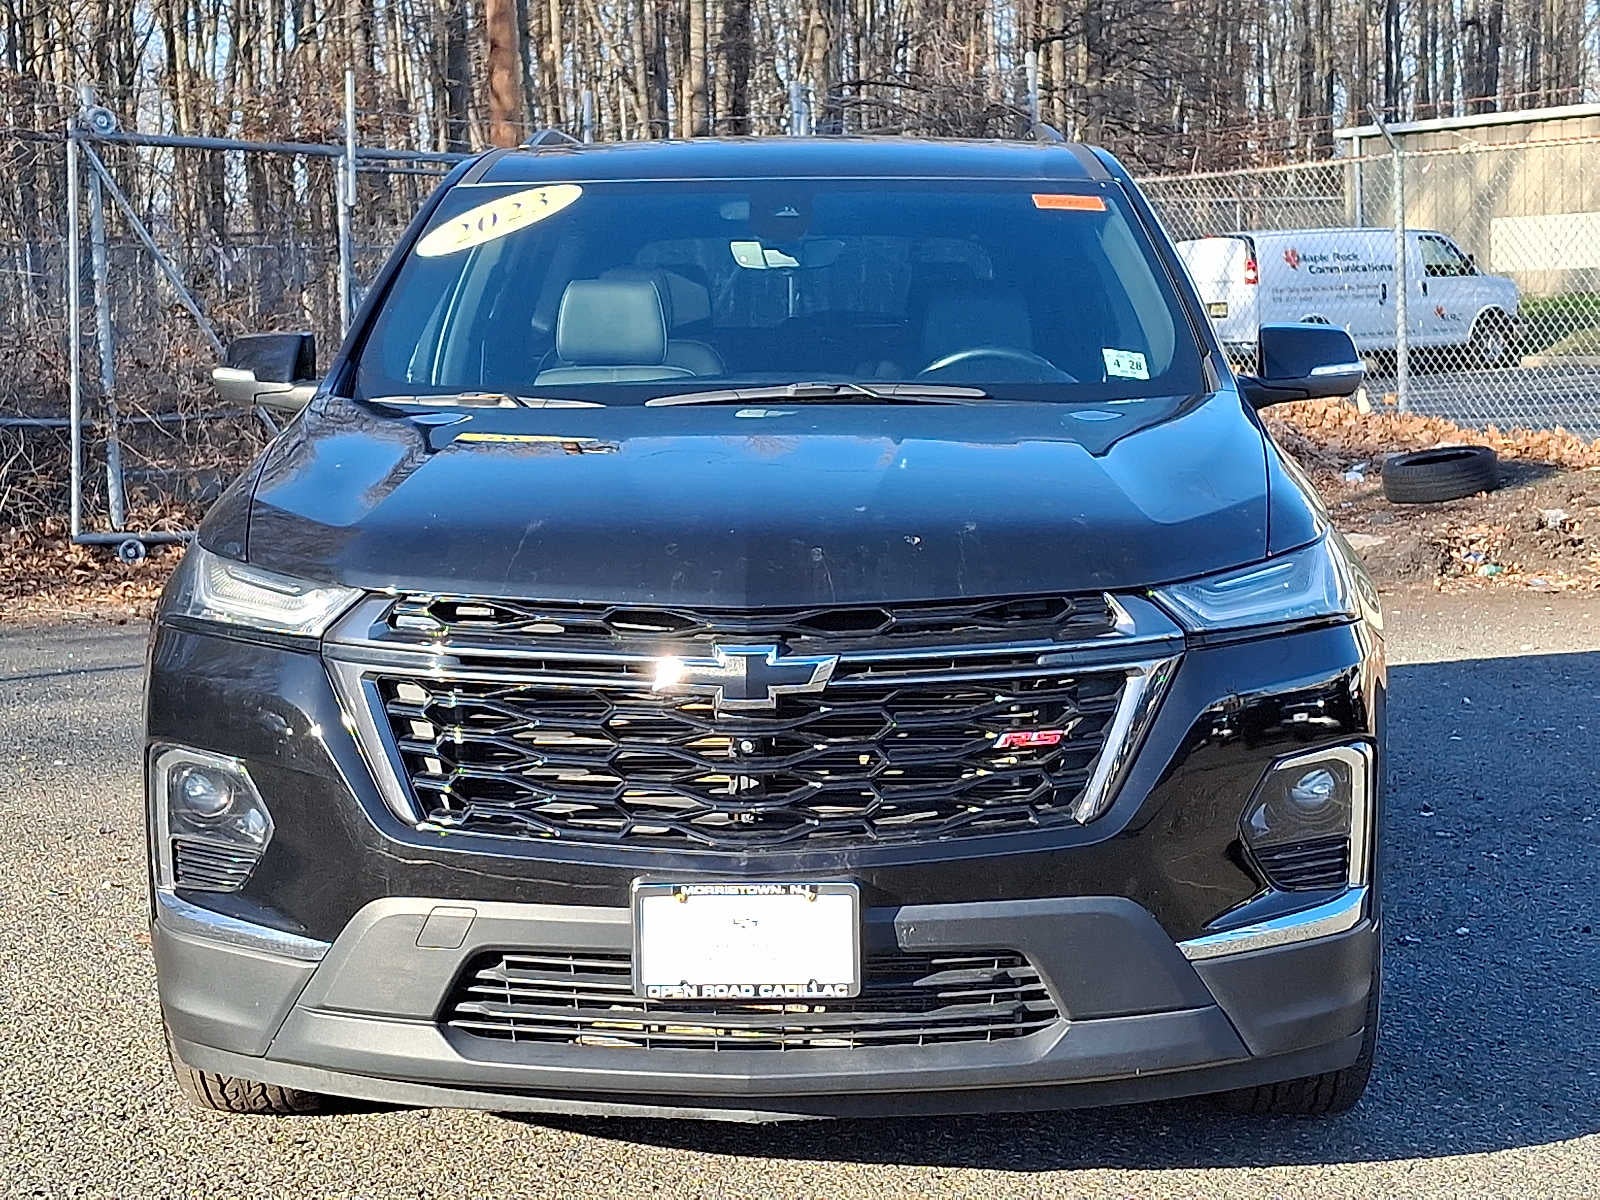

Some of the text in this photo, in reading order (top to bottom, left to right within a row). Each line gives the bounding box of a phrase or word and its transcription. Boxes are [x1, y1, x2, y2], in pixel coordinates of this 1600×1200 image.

[454, 191, 551, 245] 2023
[1332, 251, 1360, 262] Rock
[1308, 263, 1393, 275] Communications
[1113, 359, 1121, 368] 4
[993, 729, 1064, 749] RS
[646, 983, 849, 999] OPEN ROAD CADILLAC
